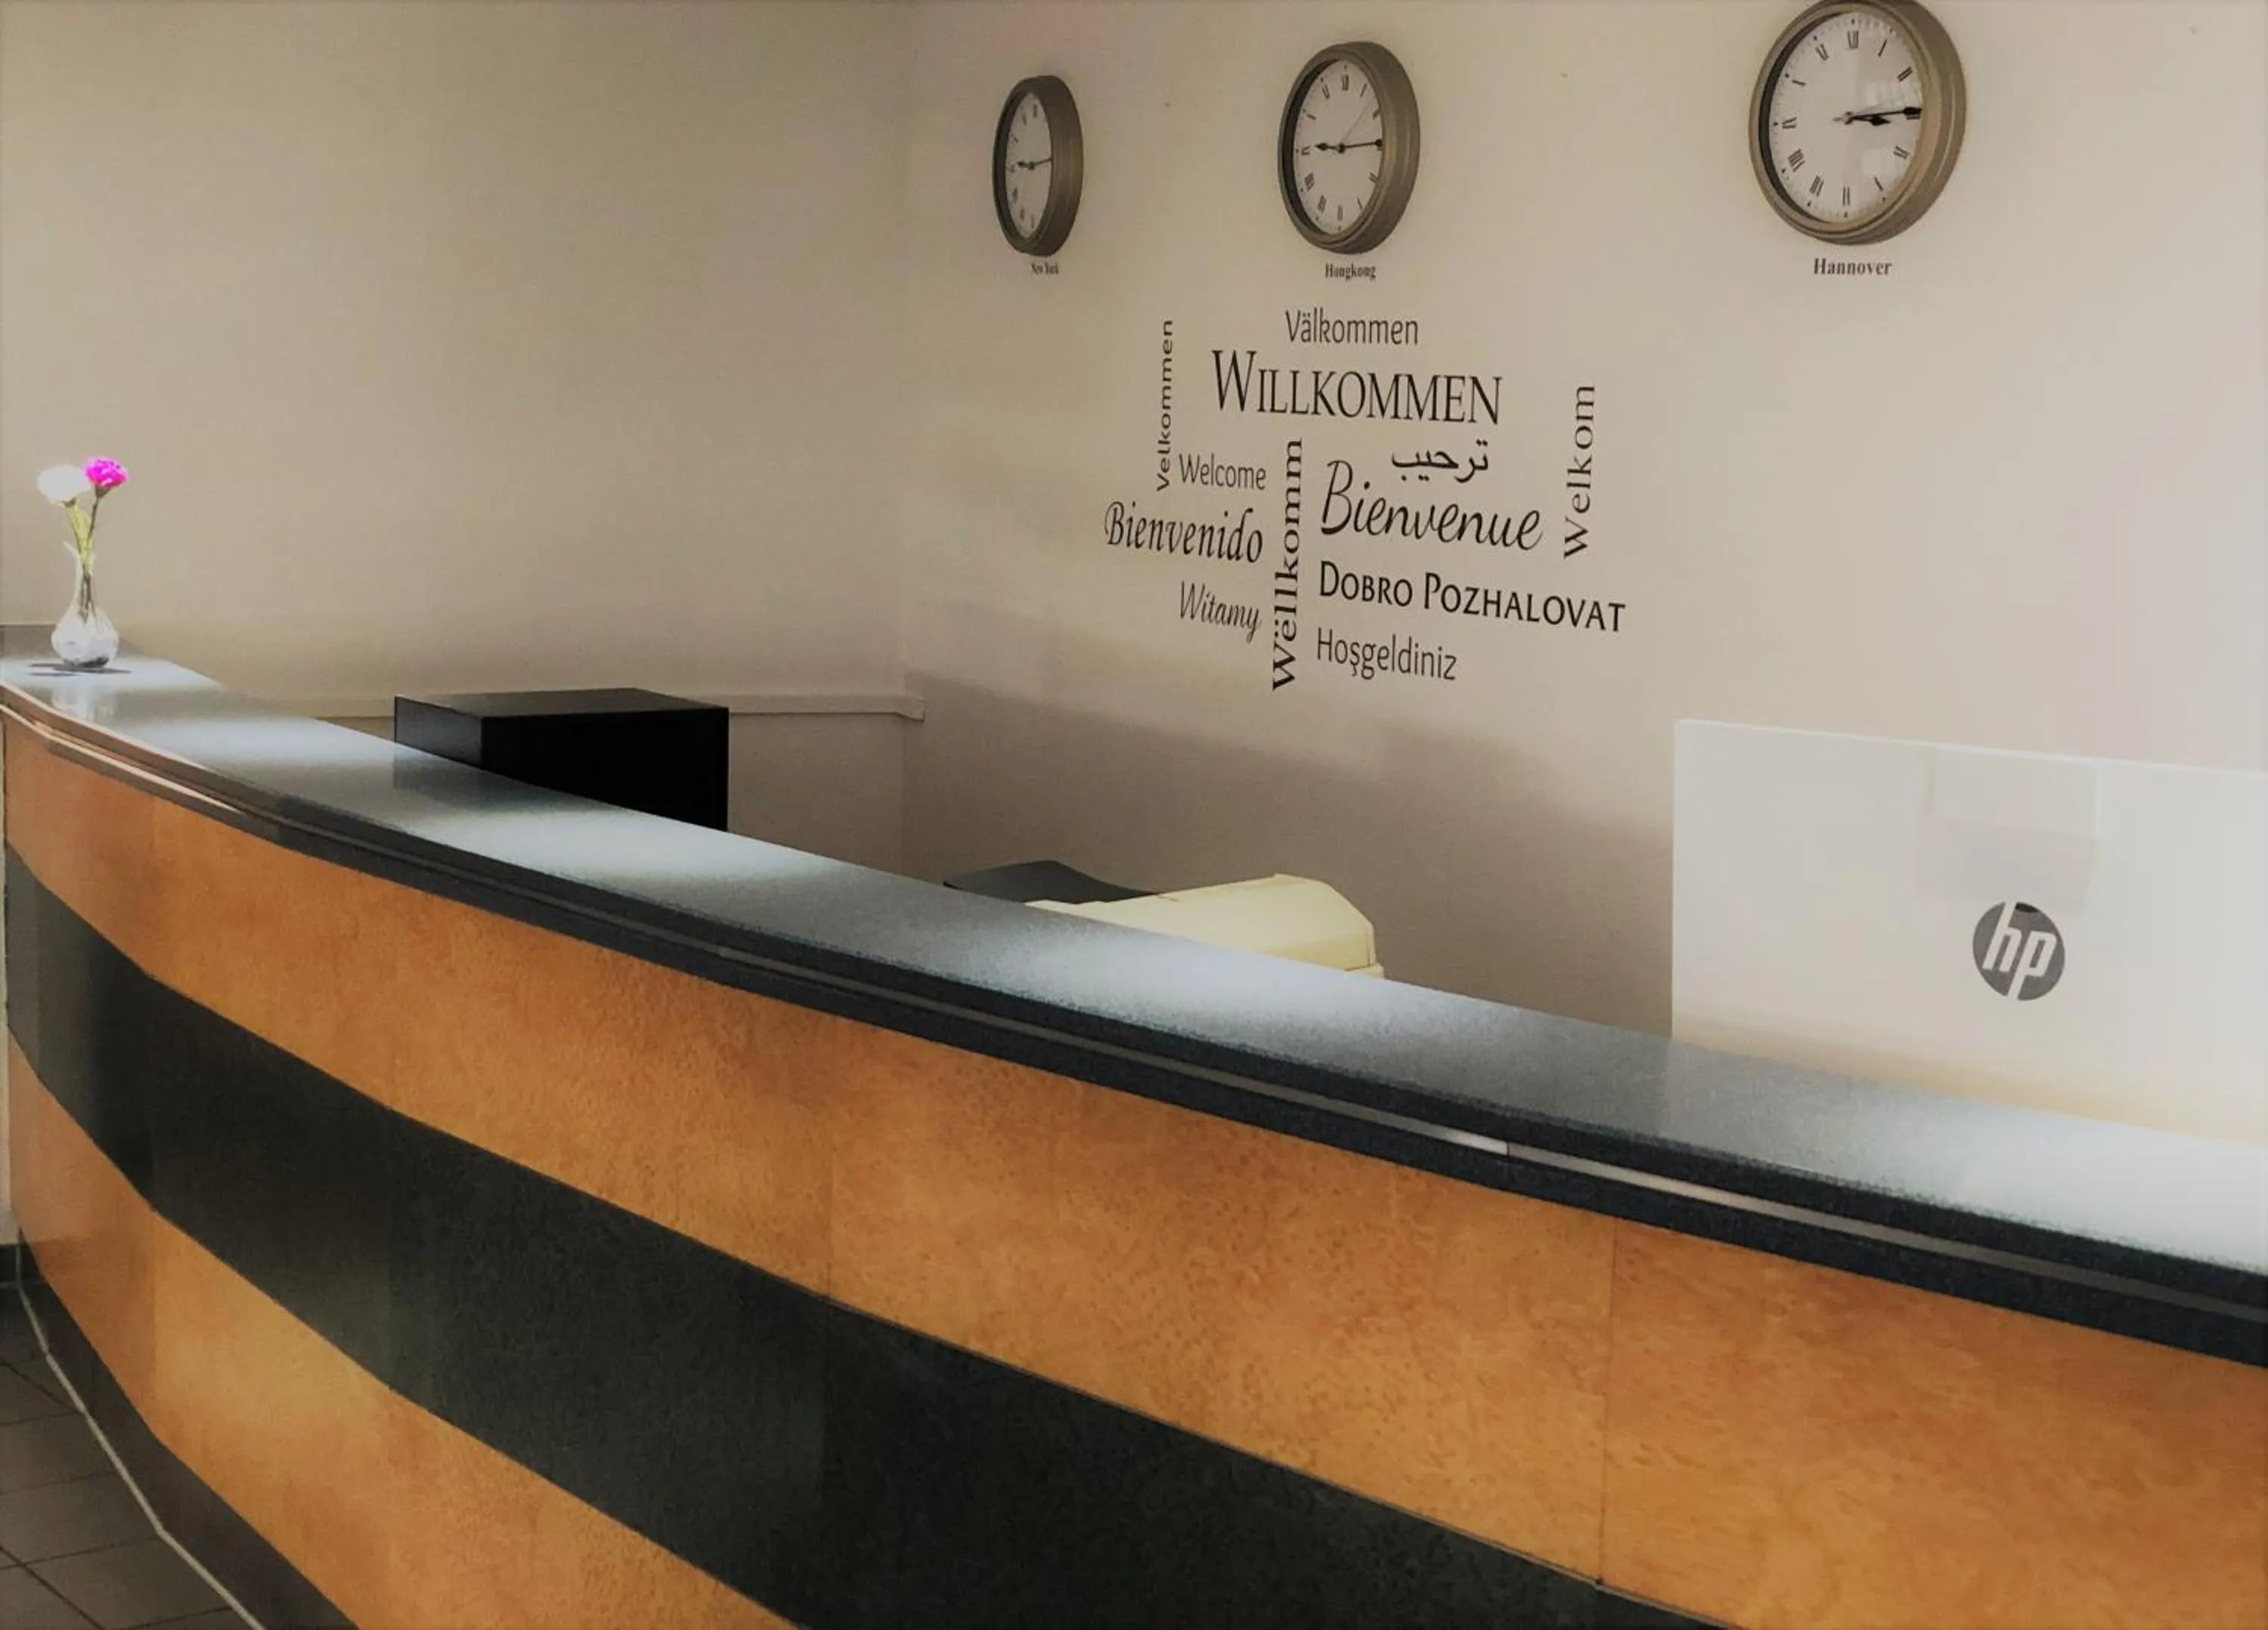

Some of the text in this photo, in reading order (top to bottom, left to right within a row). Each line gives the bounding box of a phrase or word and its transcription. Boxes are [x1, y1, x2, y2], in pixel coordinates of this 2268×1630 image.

[1325, 262, 1377, 282] Hongkong
[1814, 257, 1892, 276] Hannover
[1284, 306, 1420, 346] Välkommen
[1156, 320, 1174, 492] Velkommen
[1211, 349, 1504, 426] WILLKOMMEN
[1179, 453, 1267, 491] Welcome
[1390, 438, 1489, 485] ترحيب
[1563, 386, 1597, 560] Welkom
[1104, 500, 1264, 564] Bienvenido
[1320, 459, 1544, 551] Bienvenue
[1271, 437, 1303, 692] Wëllkomm
[1318, 559, 1627, 633] DOBRO POZHALOVAT
[1179, 580, 1263, 643] Witamy
[1317, 627, 1458, 681] Hoşgeldiniz
[1979, 900, 2059, 1001] hp
